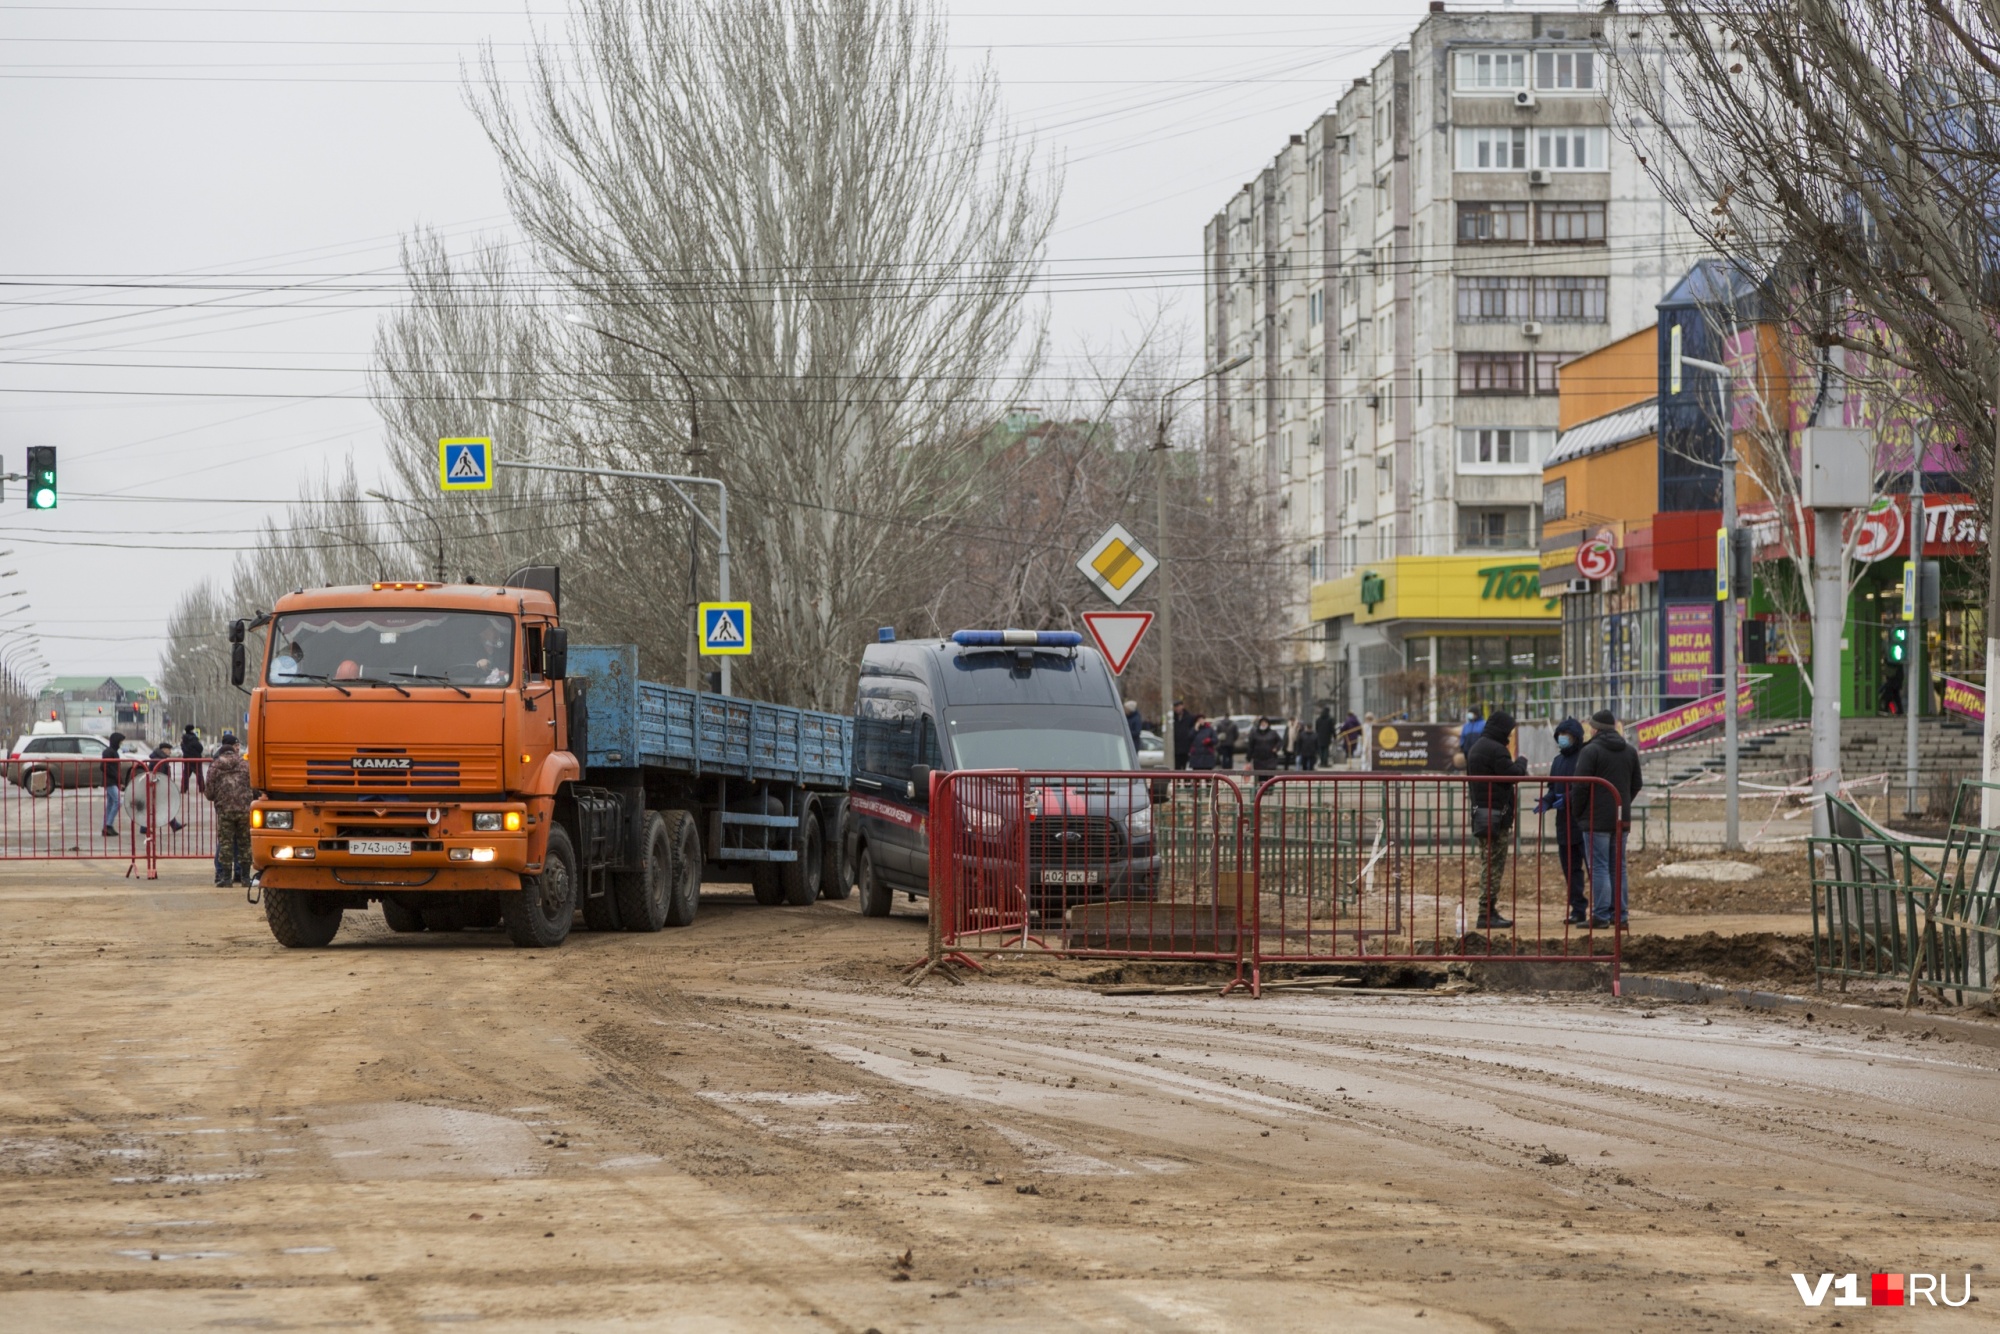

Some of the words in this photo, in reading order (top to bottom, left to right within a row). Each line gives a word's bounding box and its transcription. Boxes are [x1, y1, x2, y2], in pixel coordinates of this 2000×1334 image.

[1669, 633, 1711, 649] ВСЕГДА
[1670, 651, 1711, 665] НИЗКИЕ
[1638, 715, 1682, 743] СКИДКИ
[1379, 750, 1408, 759] Скидка
[1409, 748, 1428, 759] 20%
[352, 759, 410, 768] KAMAZ
